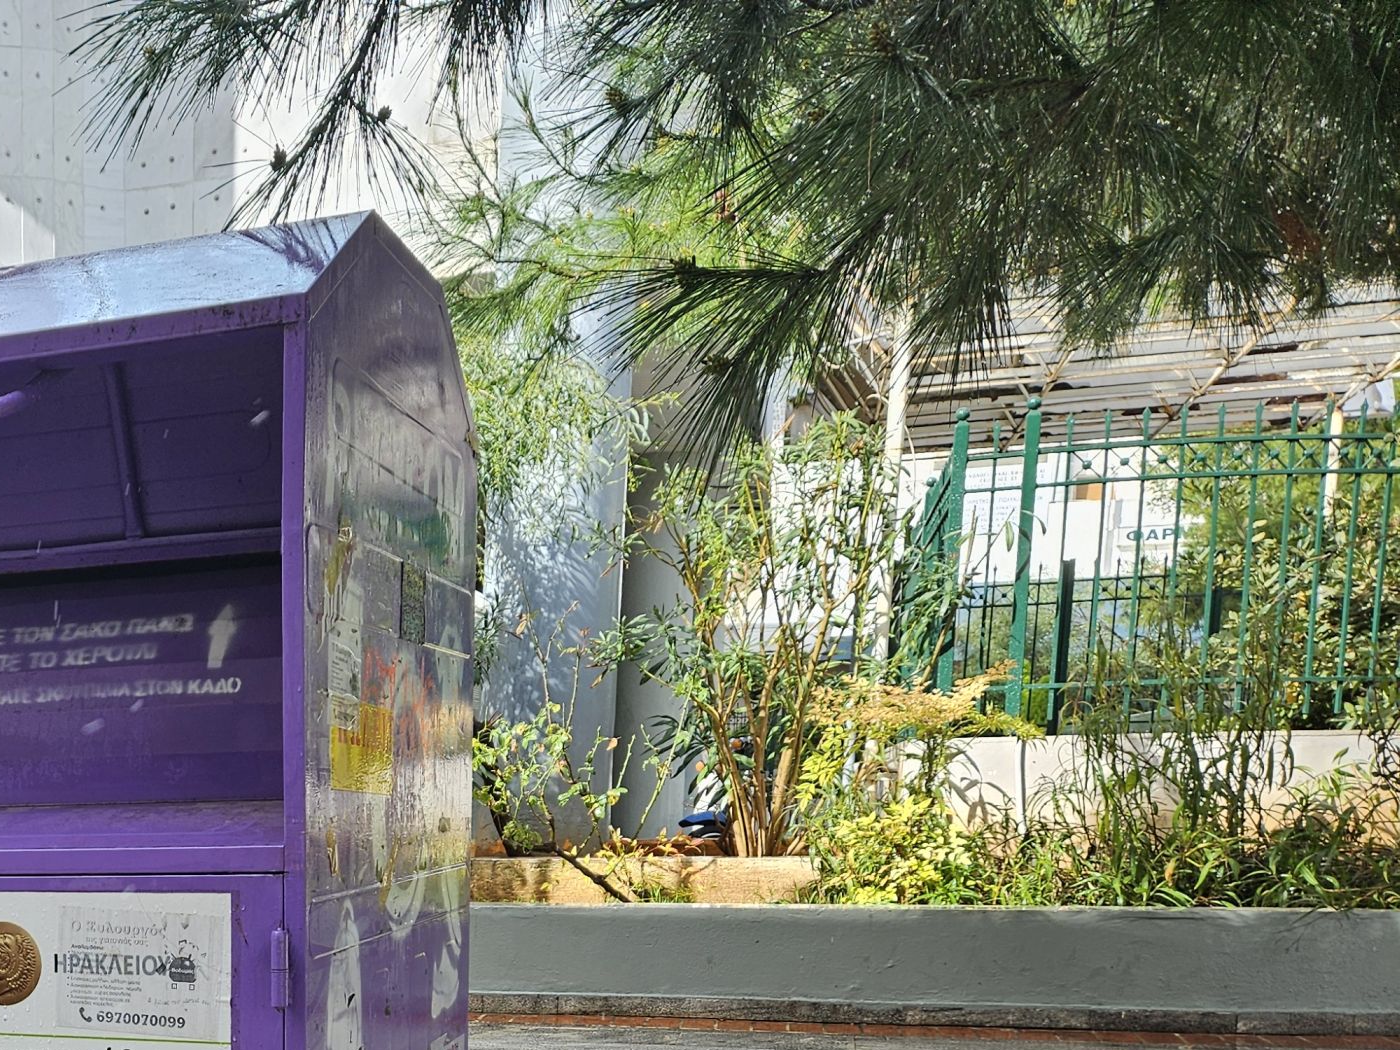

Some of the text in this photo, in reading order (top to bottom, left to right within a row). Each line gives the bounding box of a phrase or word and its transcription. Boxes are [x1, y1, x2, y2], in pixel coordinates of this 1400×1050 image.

[14, 625, 54, 644] ΤΟΝ
[59, 619, 123, 642] ΣΑΚΟ
[29, 651, 57, 668] ΤΟ
[133, 678, 183, 698] ΣΤΟΝ
[186, 677, 242, 694] ΚΑΔΟ
[96, 1010, 186, 1028] 6970070099
